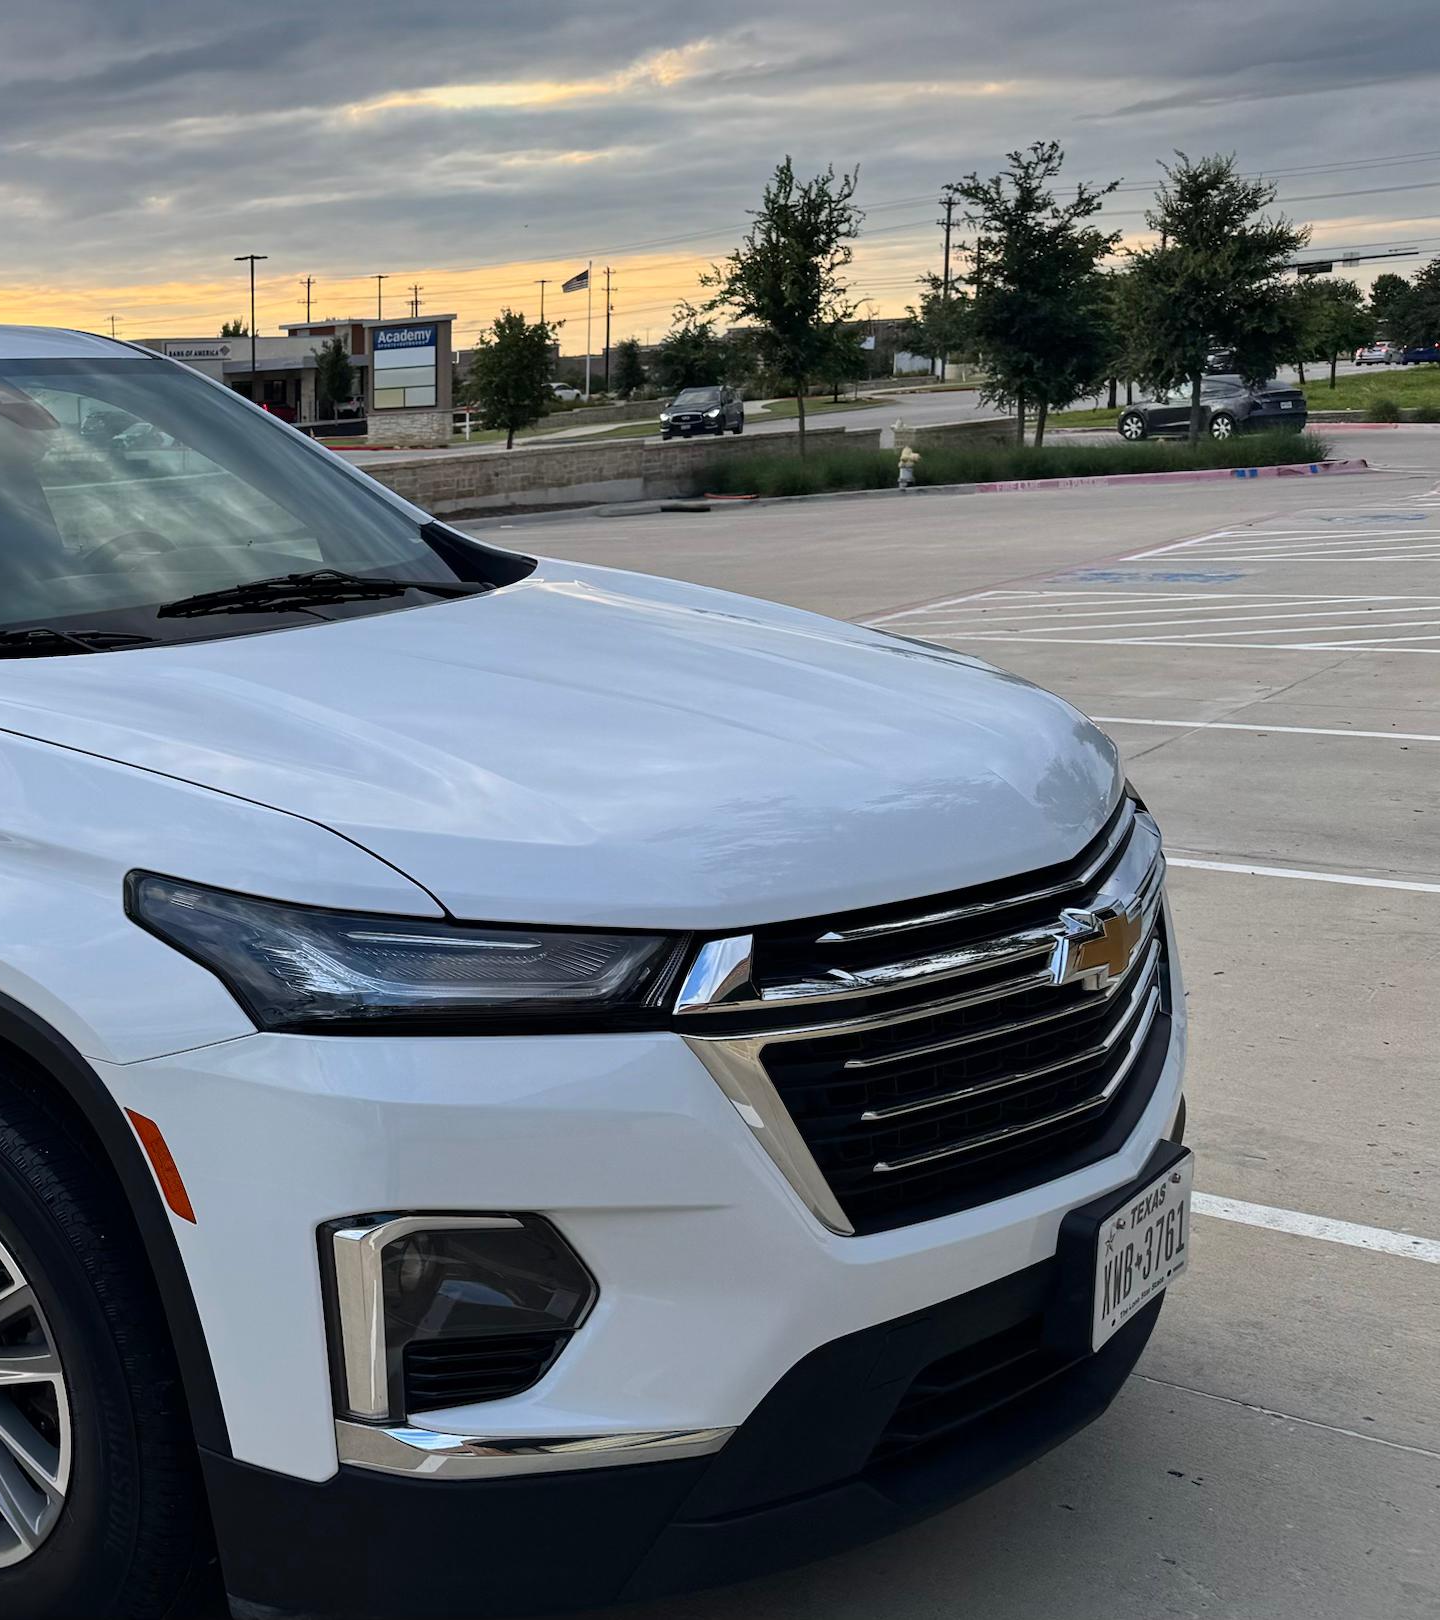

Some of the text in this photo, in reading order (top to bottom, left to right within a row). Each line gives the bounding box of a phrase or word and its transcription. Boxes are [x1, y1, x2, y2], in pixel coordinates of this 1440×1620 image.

[378, 329, 432, 343] Academy
[193, 349, 219, 357] AMERICA
[1130, 1182, 1167, 1229] TEXAS
